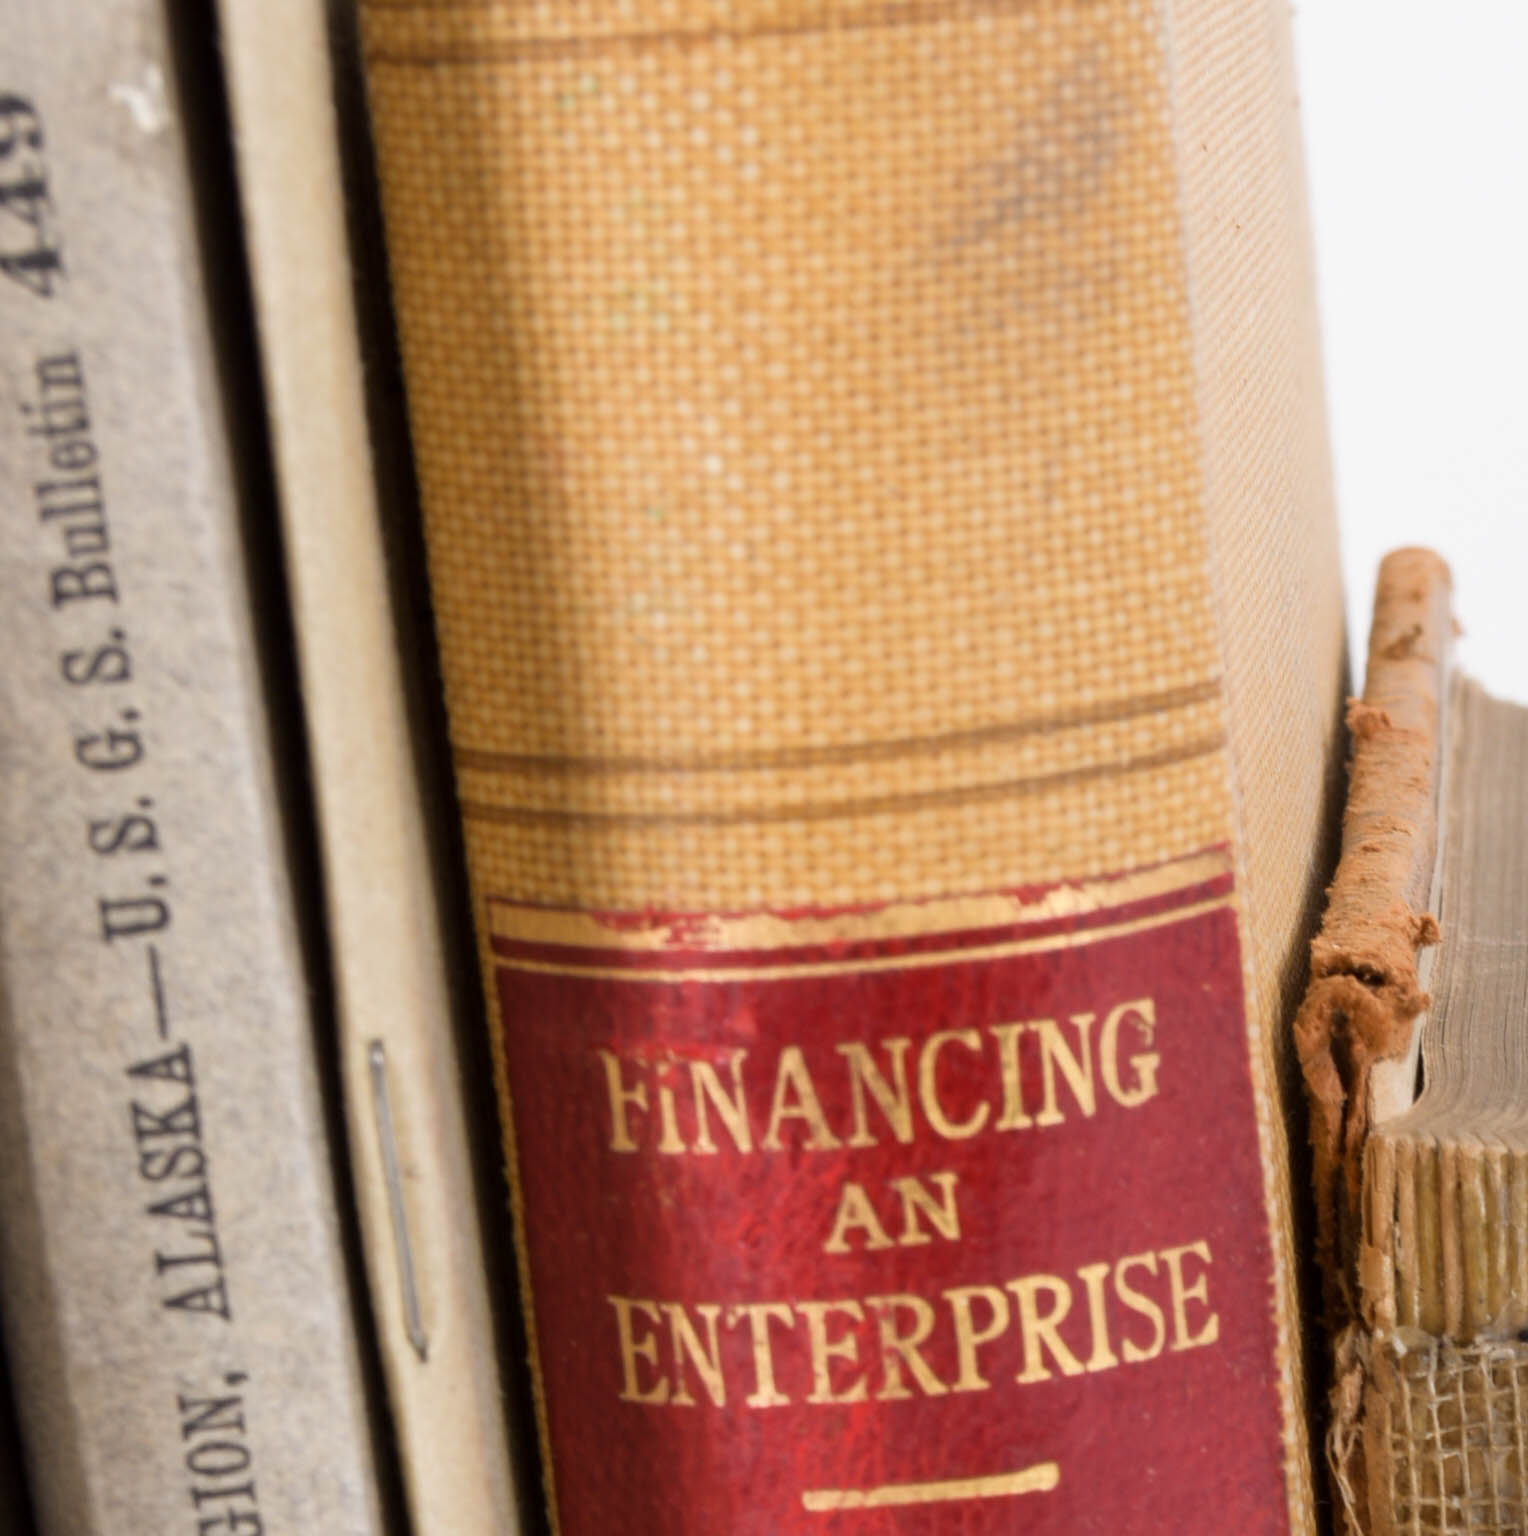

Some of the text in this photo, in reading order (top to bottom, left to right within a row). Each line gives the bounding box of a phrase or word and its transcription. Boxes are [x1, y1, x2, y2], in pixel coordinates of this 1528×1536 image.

[0, 91, 66, 299] 449
[20, 351, 118, 609] Bulletin
[61, 629, 131, 686] S.
[75, 709, 144, 772] G.
[88, 797, 161, 857] S.
[600, 998, 1161, 1156] FINANCING
[824, 1171, 962, 1254] AN
[606, 1240, 1221, 1408] ENTERPRISE
